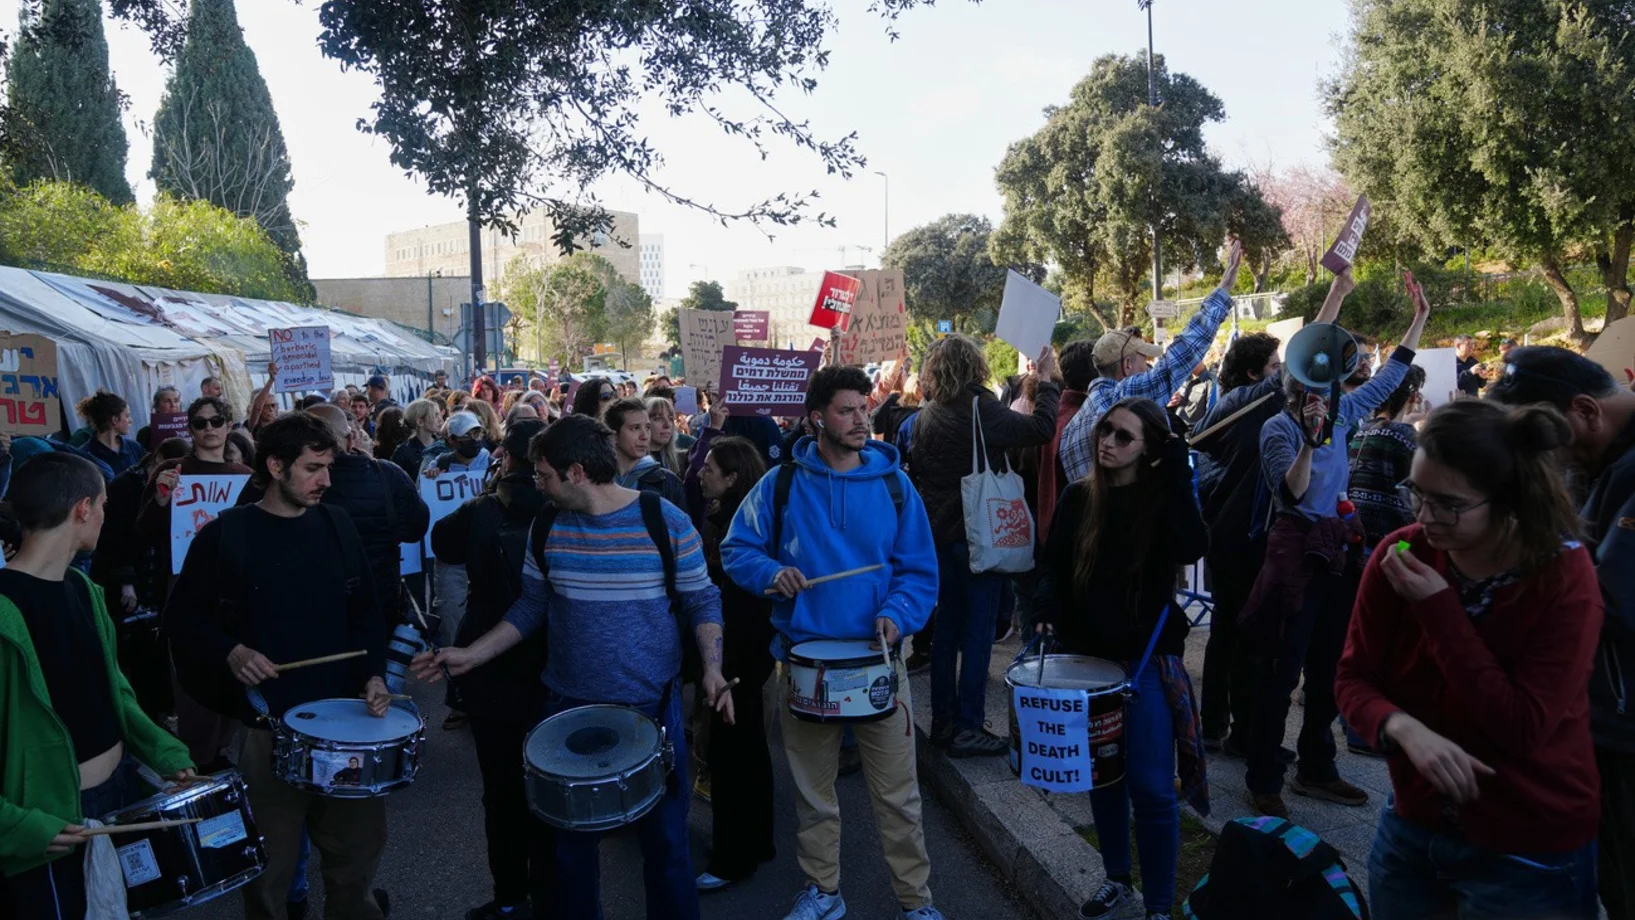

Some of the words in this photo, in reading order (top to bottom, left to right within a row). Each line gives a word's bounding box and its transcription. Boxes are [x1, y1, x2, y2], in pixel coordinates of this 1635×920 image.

[273, 329, 292, 341] NO
[301, 331, 309, 340] to
[314, 330, 324, 339] the
[280, 342, 317, 352] barbaric
[282, 352, 317, 363] genocidal
[740, 352, 770, 367] دموية
[773, 354, 805, 370] حكومة
[736, 366, 763, 377] דמים
[766, 367, 804, 379] ממשלת
[772, 381, 800, 392] تقتلنا
[727, 390, 754, 402] כולנו
[756, 391, 771, 402] את
[773, 392, 804, 402] הורגת
[176, 481, 232, 506] מוות
[1020, 696, 1083, 712] REFUSE
[1037, 721, 1065, 735] THE
[1029, 742, 1079, 759] DEATH
[1031, 767, 1079, 783] CULT!
